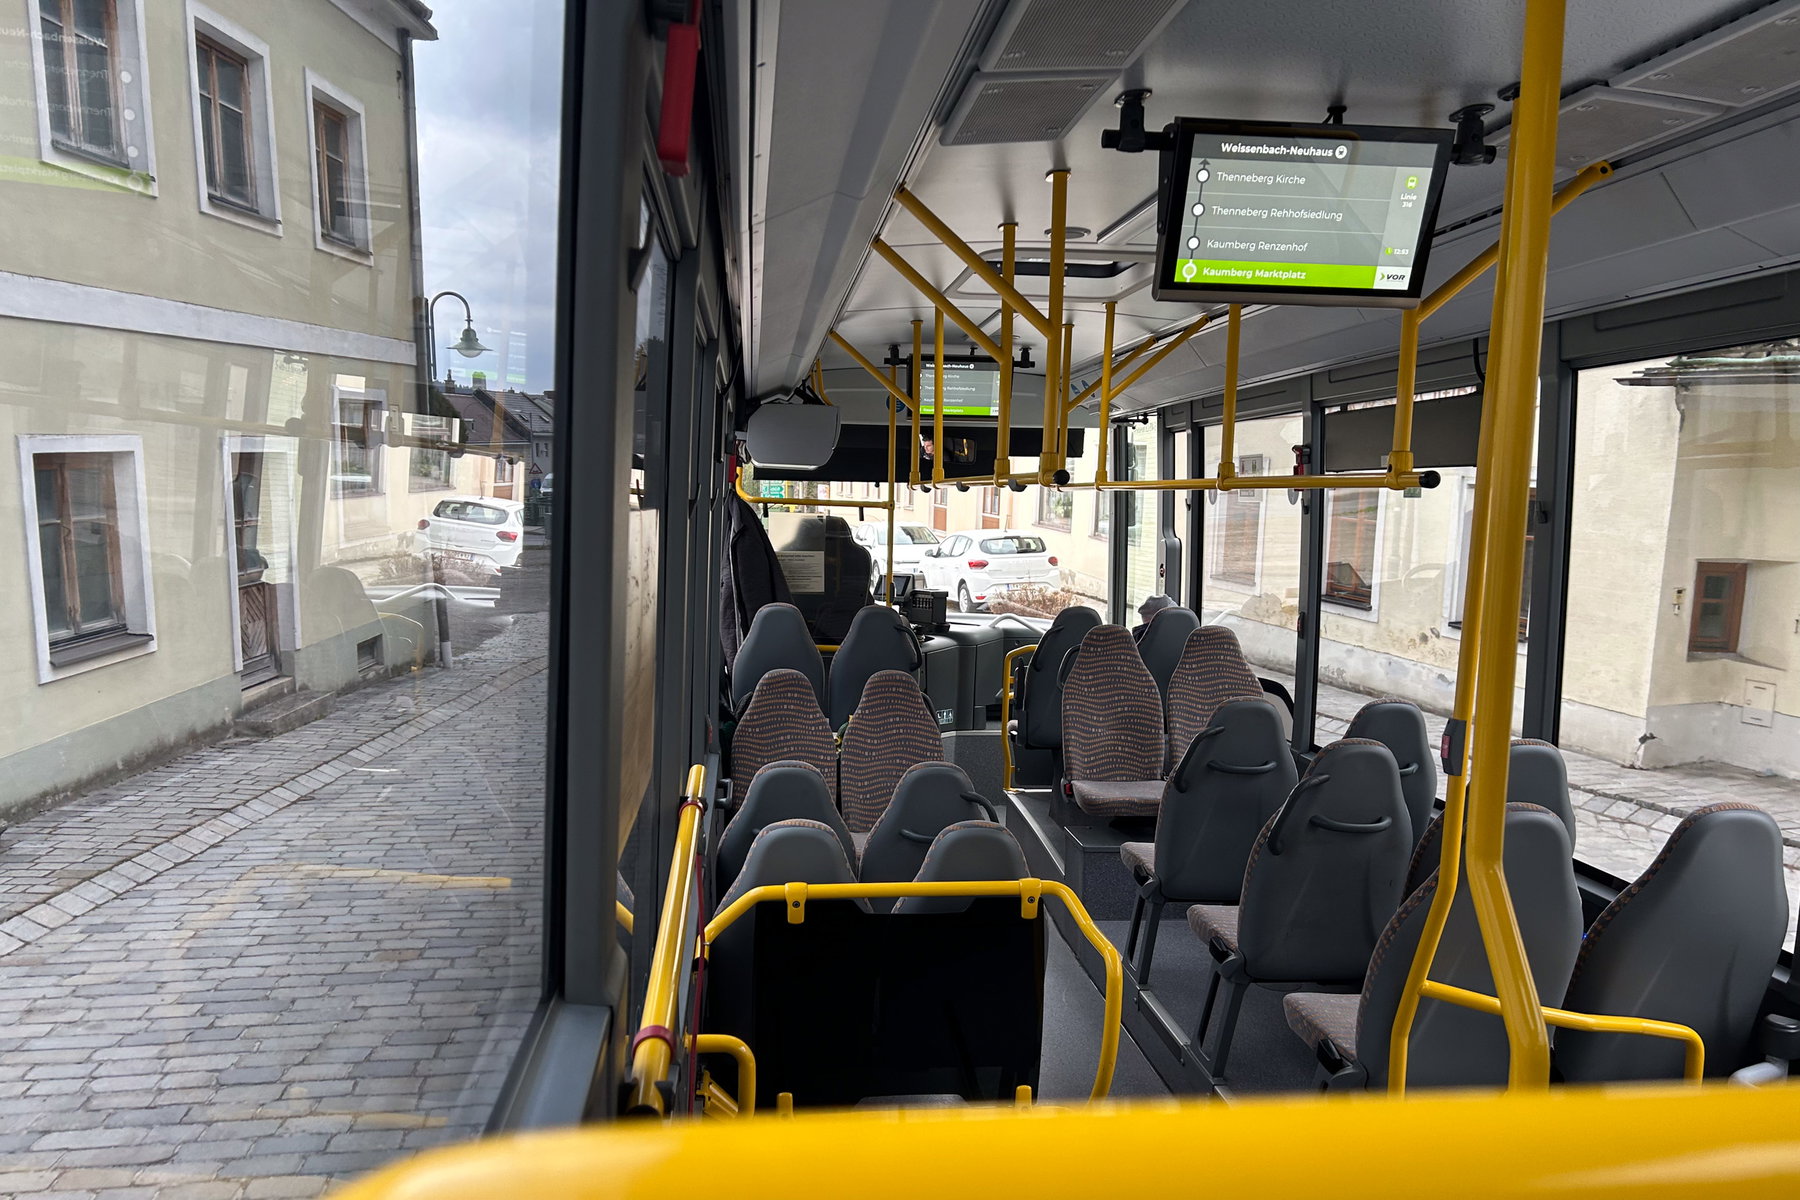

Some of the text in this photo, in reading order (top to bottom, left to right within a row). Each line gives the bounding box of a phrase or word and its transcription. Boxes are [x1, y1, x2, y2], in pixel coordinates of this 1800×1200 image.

[1221, 142, 1334, 157] Weissenbach-Neuhaus
[1217, 171, 1306, 185] Thenneberg Kirche
[1400, 193, 1417, 201] Linie
[1212, 205, 1343, 221] Thenneberg Rehhofsiedlung
[1207, 239, 1308, 252] Kaumberg Renzenhof
[1202, 266, 1306, 280] Kaumberg Marktplatz
[1386, 273, 1406, 281] VOR
